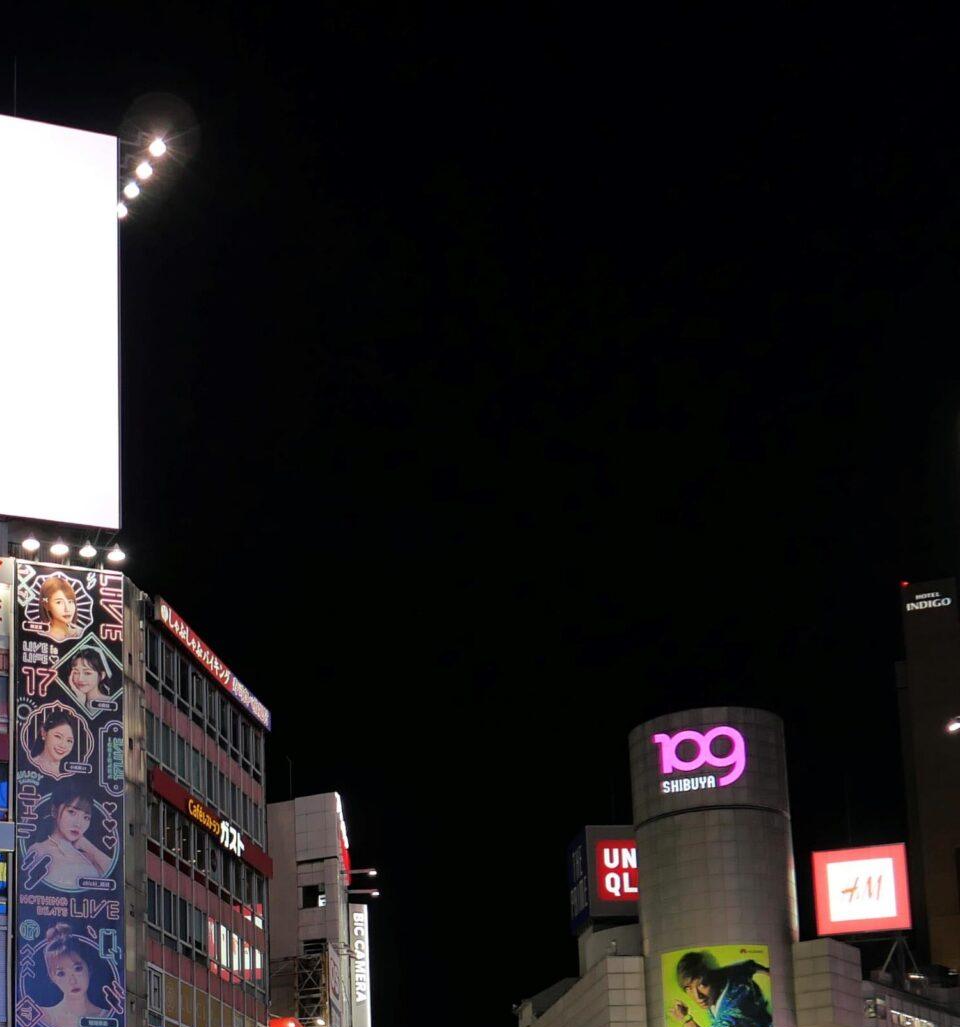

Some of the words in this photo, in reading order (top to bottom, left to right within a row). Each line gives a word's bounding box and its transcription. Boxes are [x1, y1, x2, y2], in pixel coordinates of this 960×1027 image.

[906, 597, 952, 611] INDIGO
[915, 592, 940, 600] HOTEL
[22, 666, 57, 697] 17
[653, 726, 746, 787] 109
[662, 775, 716, 794] SHIBUYA
[220, 820, 245, 857] ガスト
[603, 848, 638, 869] UN
[605, 872, 639, 896] QL
[70, 898, 120, 920] LIVE
[353, 912, 365, 938] BIC
[353, 939, 368, 1003] CAMERA
